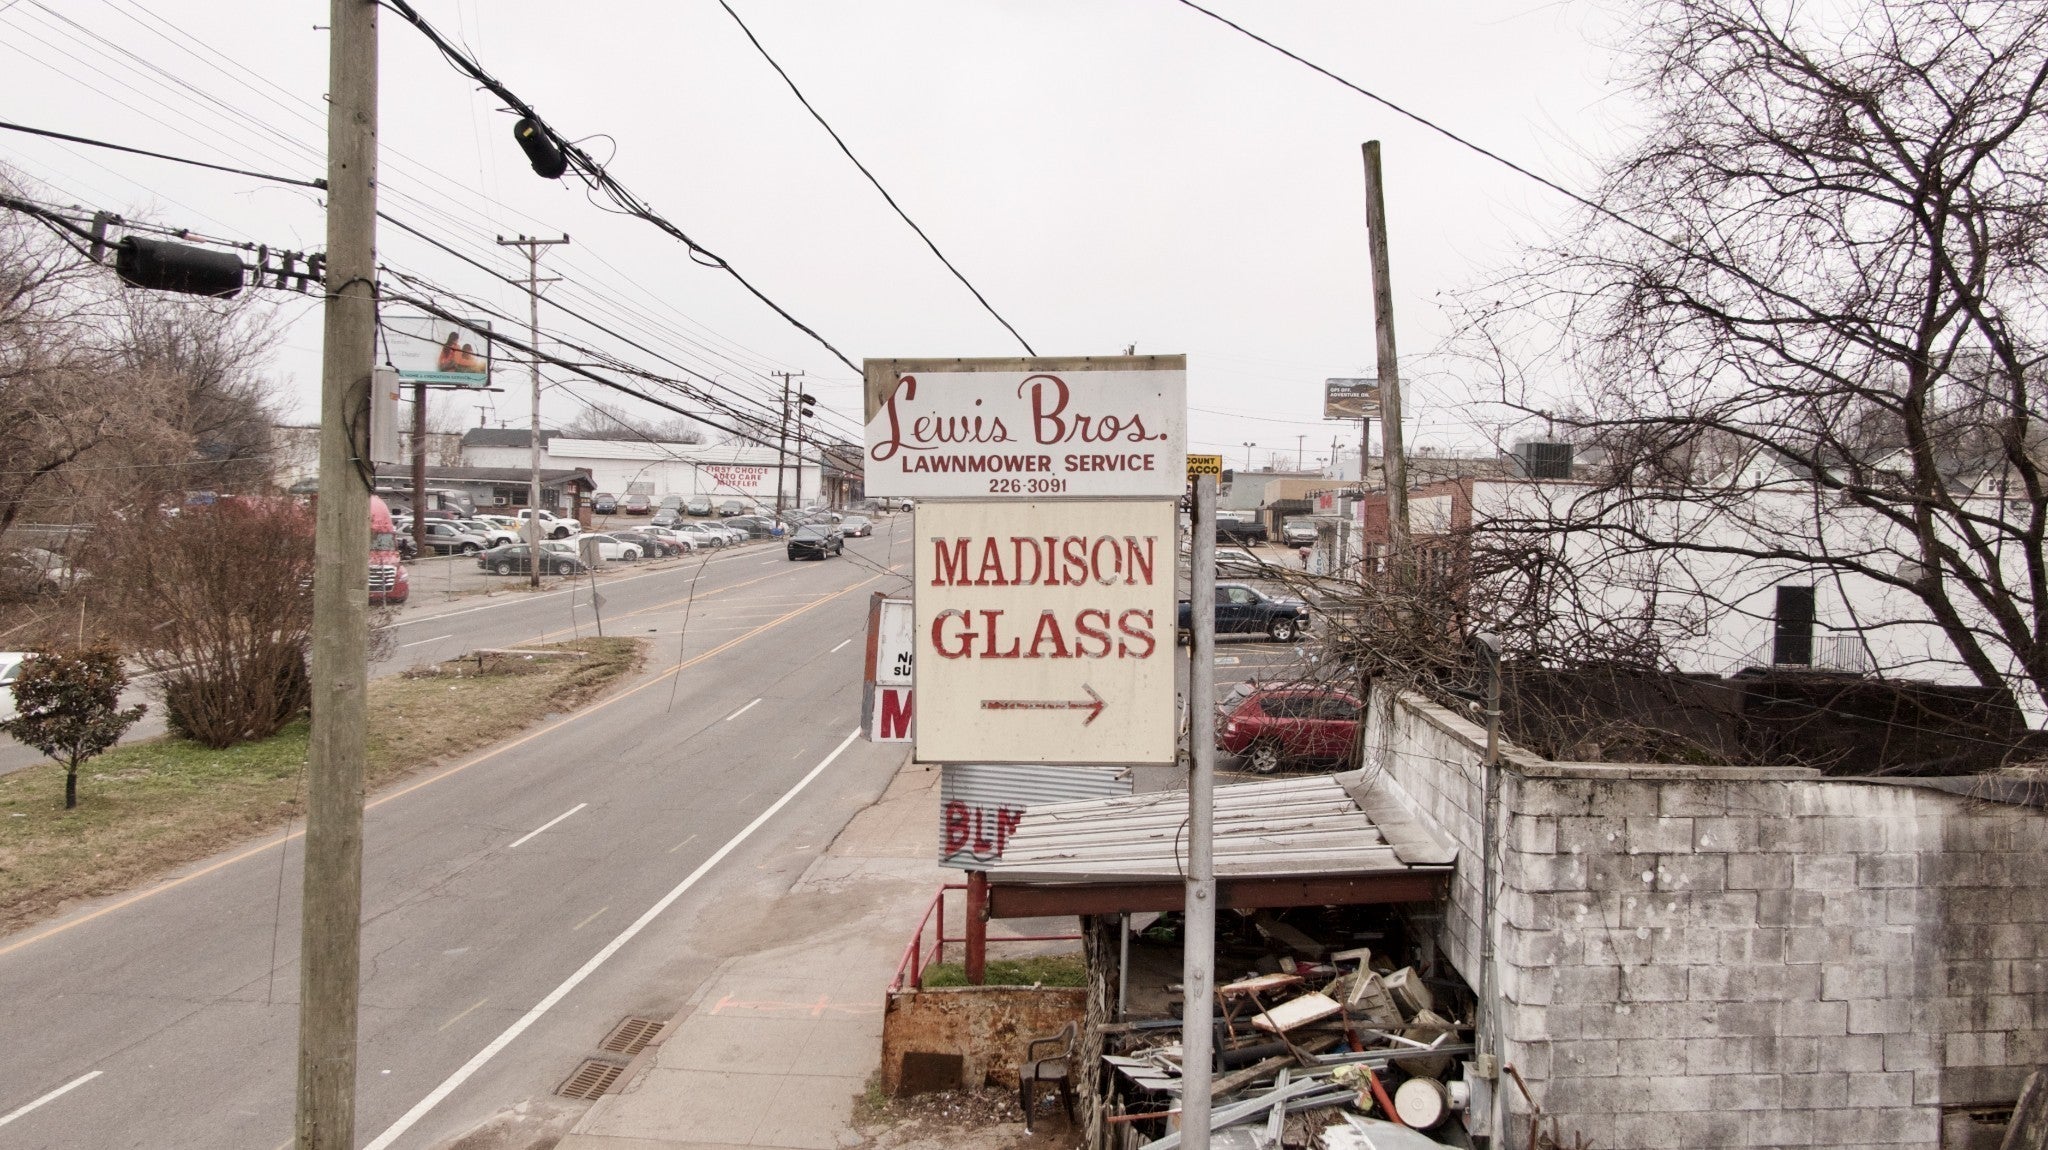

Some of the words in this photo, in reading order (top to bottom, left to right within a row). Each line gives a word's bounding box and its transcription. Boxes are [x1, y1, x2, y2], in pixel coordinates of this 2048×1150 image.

[871, 375, 1017, 461] Lewis
[1017, 374, 1168, 446] Bros.
[902, 455, 1051, 473] LAWNMOWER
[1065, 454, 1155, 471] SERVICE
[989, 479, 1067, 493] 226-3091
[930, 535, 1159, 586] MADISON
[931, 609, 1157, 660] GLASS
